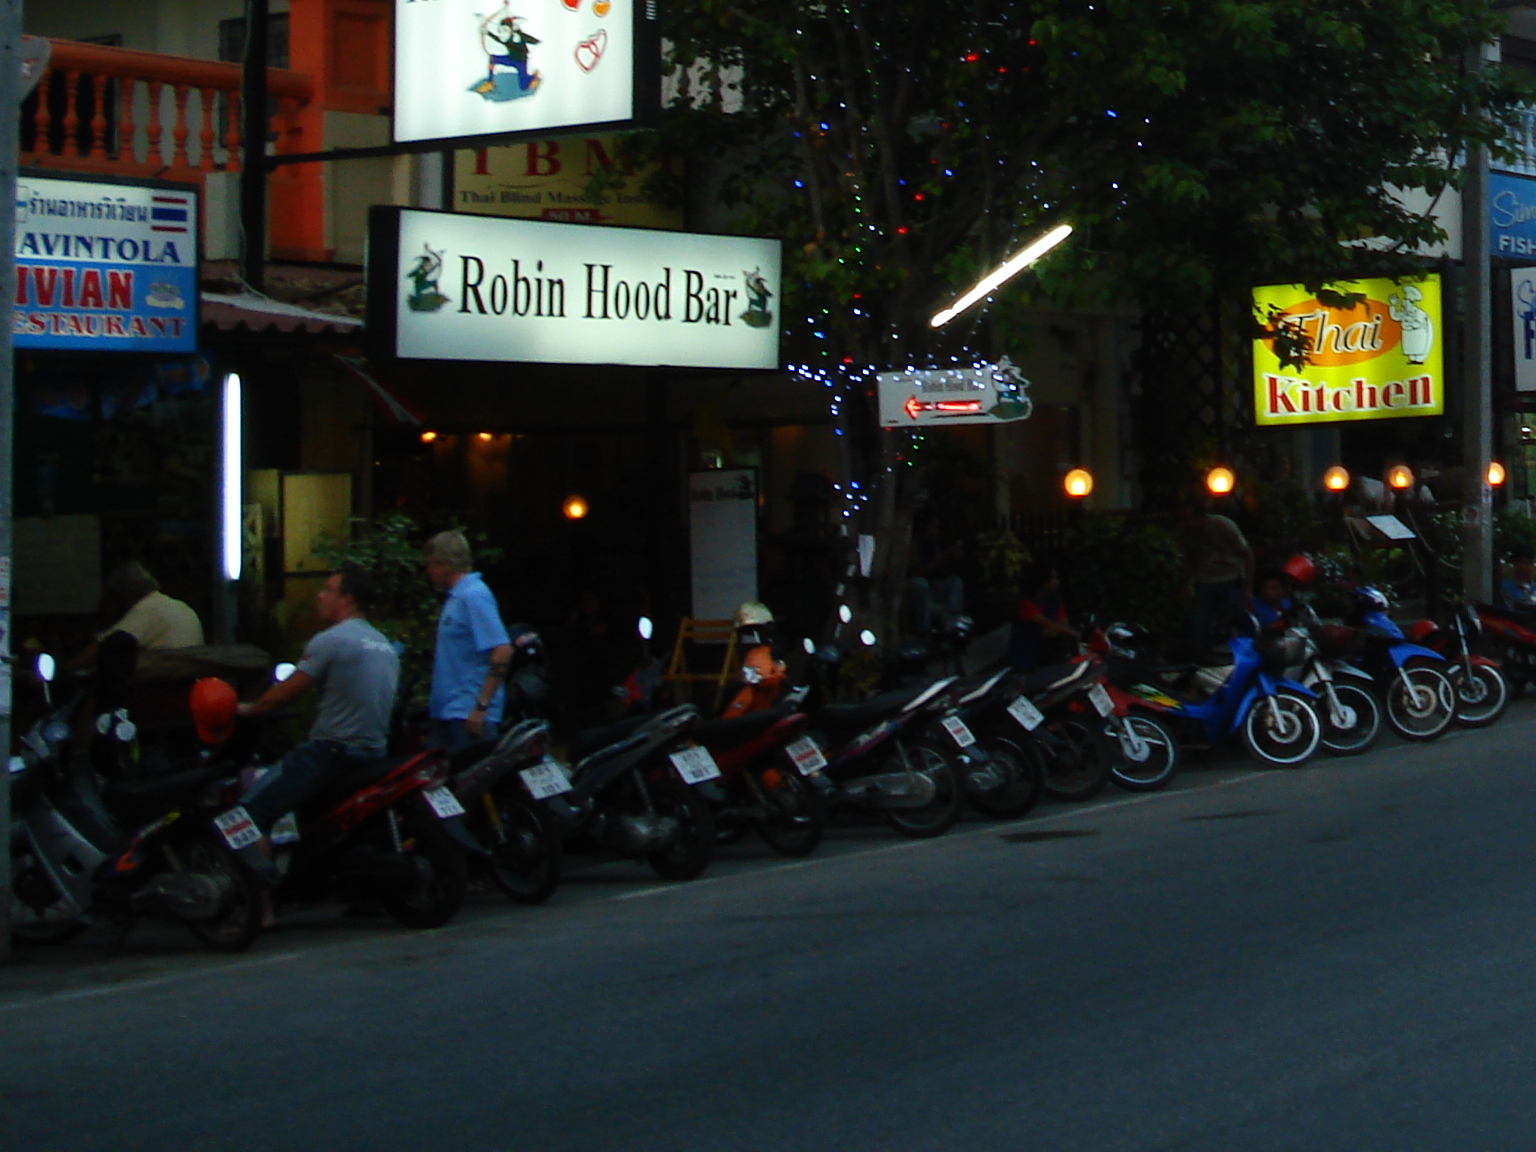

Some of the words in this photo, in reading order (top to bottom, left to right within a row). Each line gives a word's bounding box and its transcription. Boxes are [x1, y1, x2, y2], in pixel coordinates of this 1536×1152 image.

[19, 232, 181, 263] AVINTOLA
[15, 265, 133, 310] IVIAN
[458, 255, 566, 317] Robin
[582, 263, 672, 320] Hood
[681, 269, 738, 326] Bar
[12, 311, 187, 339] ESTAURANT
[1278, 308, 1383, 355] Thai
[1263, 373, 1436, 417] Kitchen
